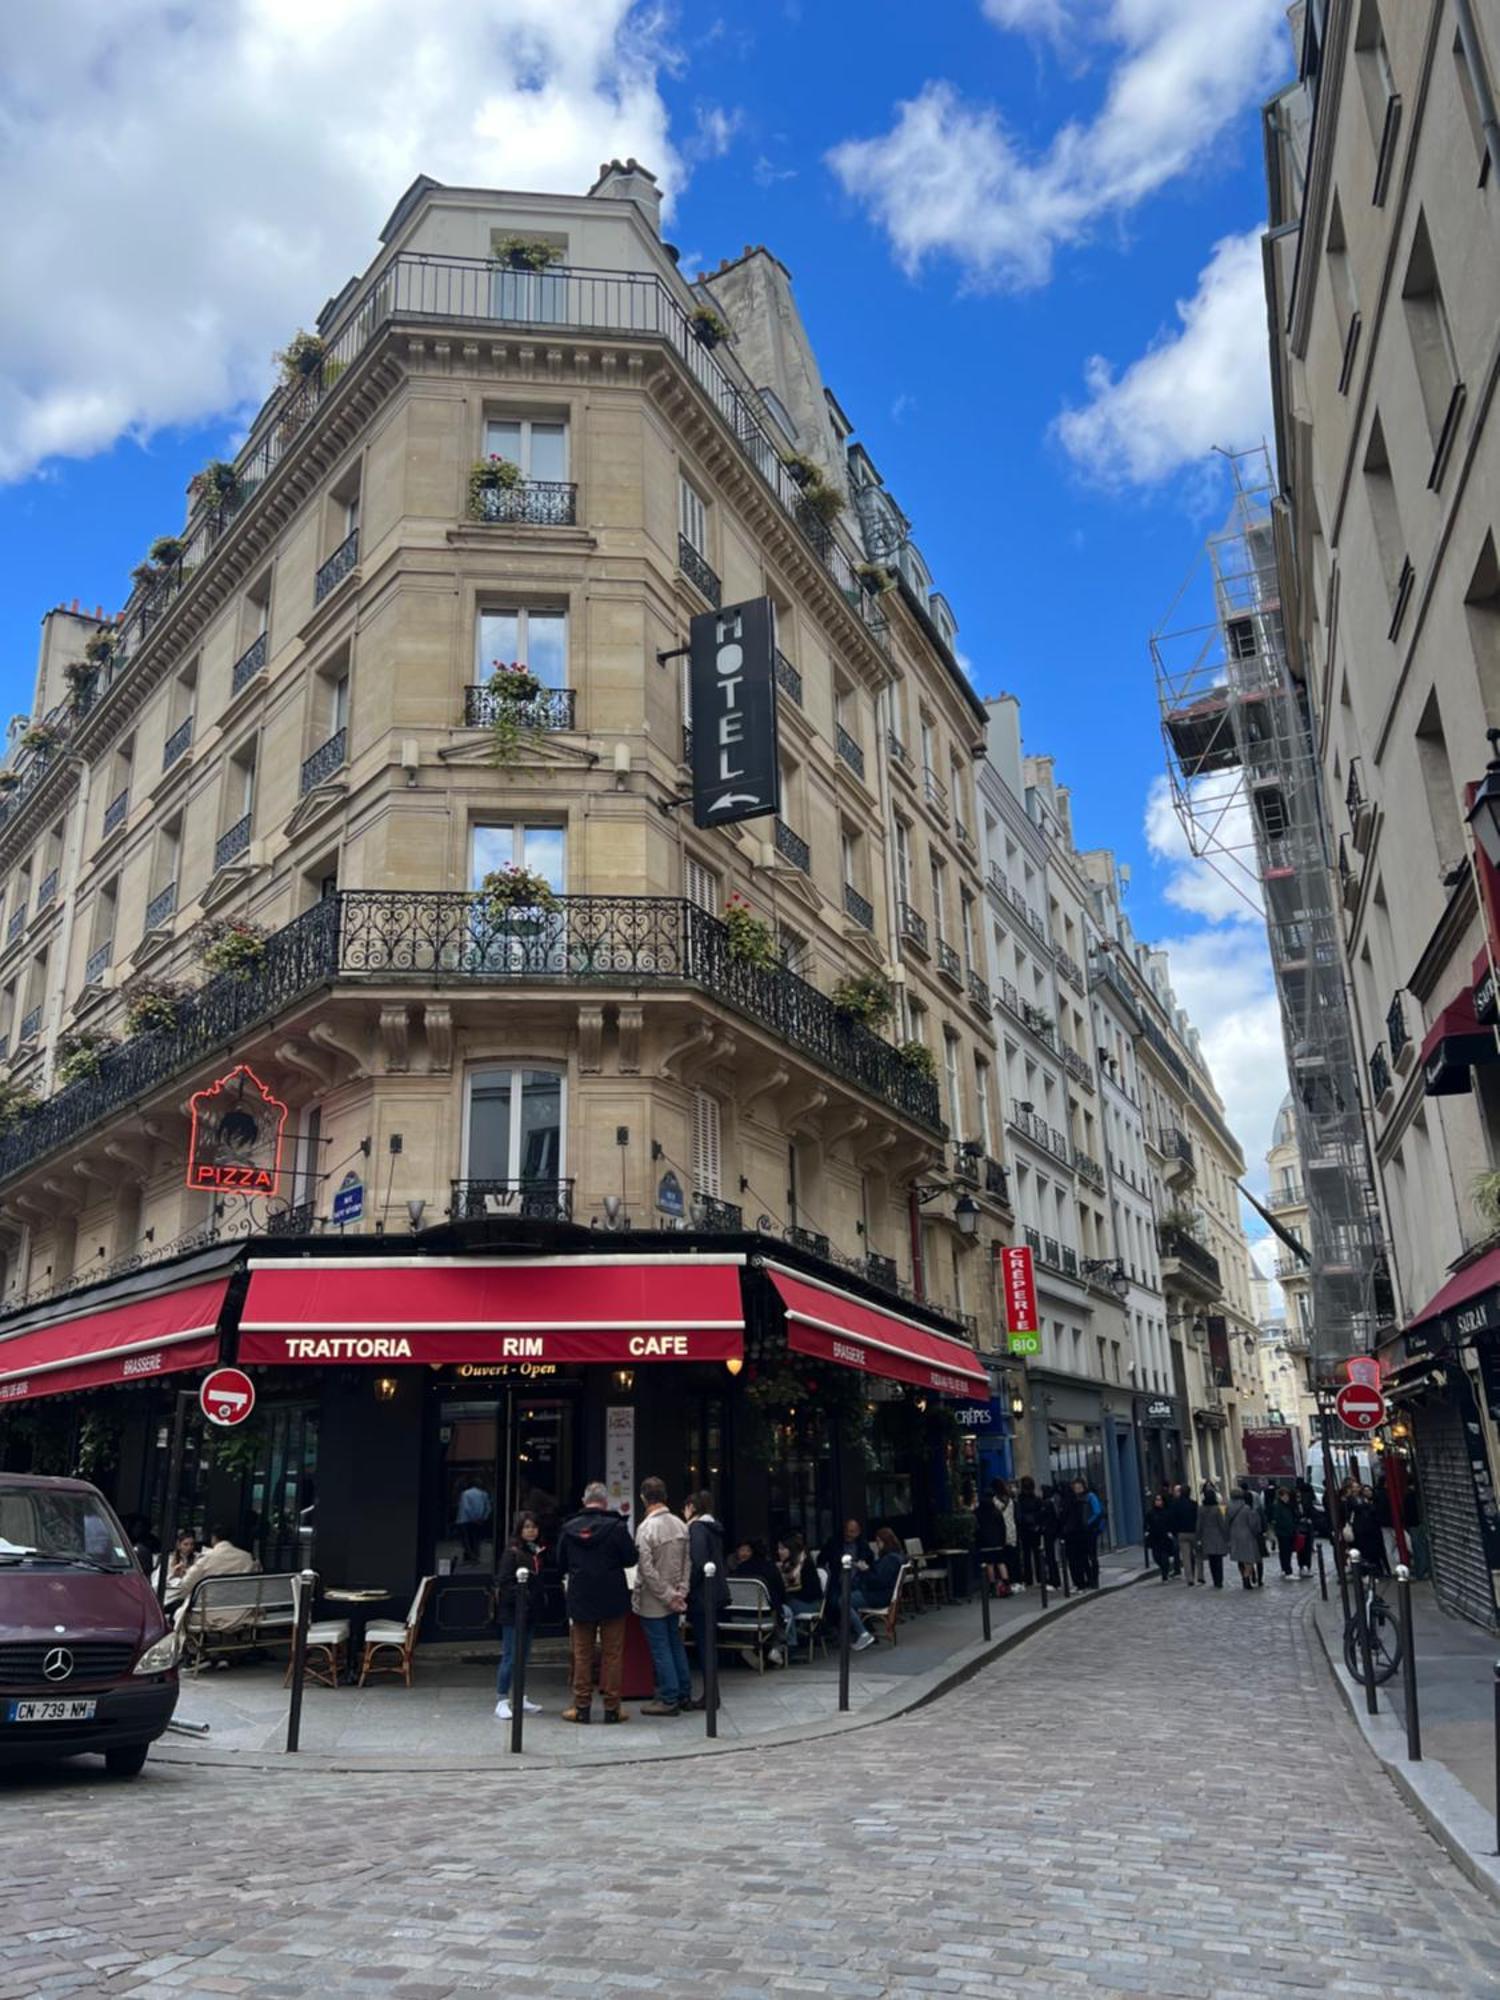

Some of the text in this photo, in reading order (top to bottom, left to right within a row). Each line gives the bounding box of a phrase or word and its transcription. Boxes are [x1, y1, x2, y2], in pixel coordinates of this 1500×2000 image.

[716, 614, 744, 781] HOTEL
[198, 1166, 270, 1186] PIZZA
[285, 1336, 688, 1358] TRATTORIA RIM CAFE
[1012, 1338, 1037, 1352] BIO
[123, 1353, 162, 1375] BRASSERIE
[460, 1363, 509, 1377] Ouvert
[519, 1362, 556, 1379] Open
